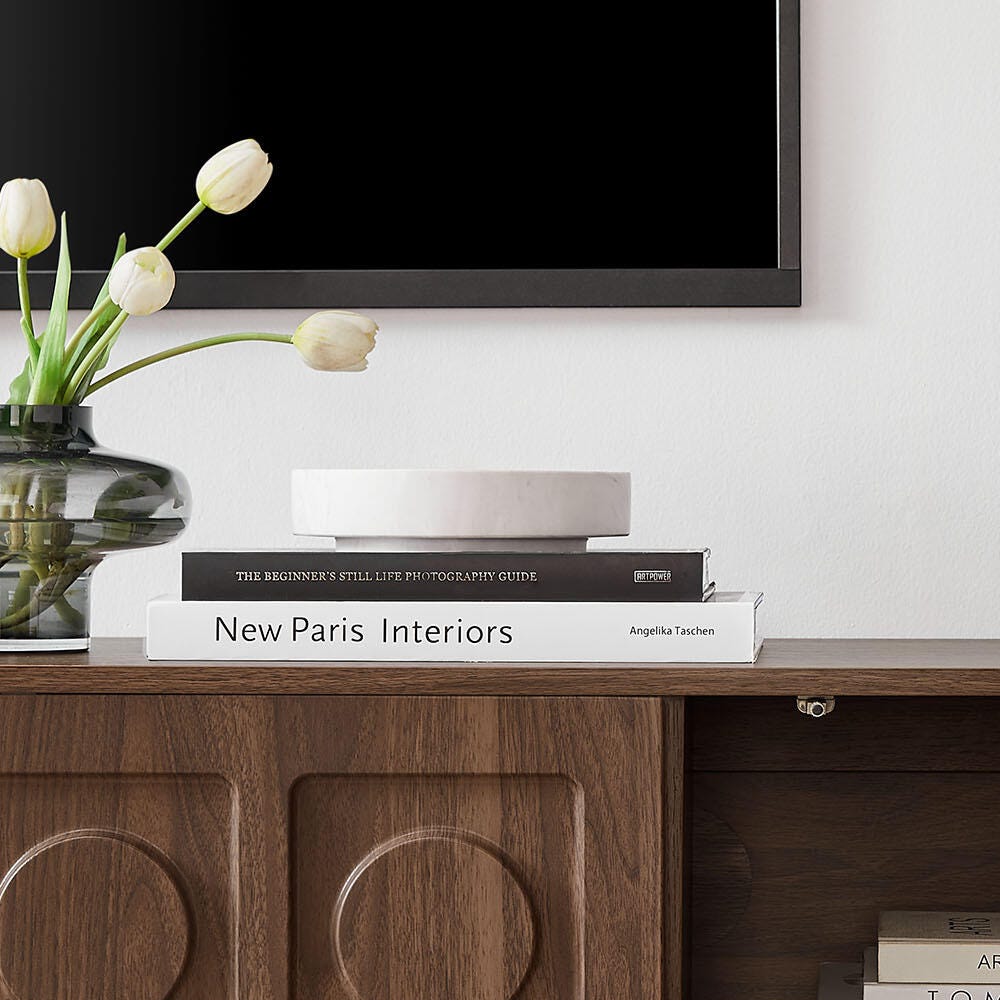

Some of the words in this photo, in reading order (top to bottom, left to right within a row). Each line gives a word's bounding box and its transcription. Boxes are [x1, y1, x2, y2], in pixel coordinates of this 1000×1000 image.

[235, 570, 262, 582] THE
[339, 570, 373, 582] STILL
[375, 570, 402, 582] LIFE
[405, 570, 496, 582] PHOTOGRAPHY
[498, 570, 538, 582] GUIDE
[636, 572, 672, 581] ARTPOWER
[215, 616, 283, 643] New
[292, 616, 364, 643] Paris
[382, 617, 513, 644] Interiors
[629, 625, 673, 638] Angelika
[674, 626, 715, 636] Taschen
